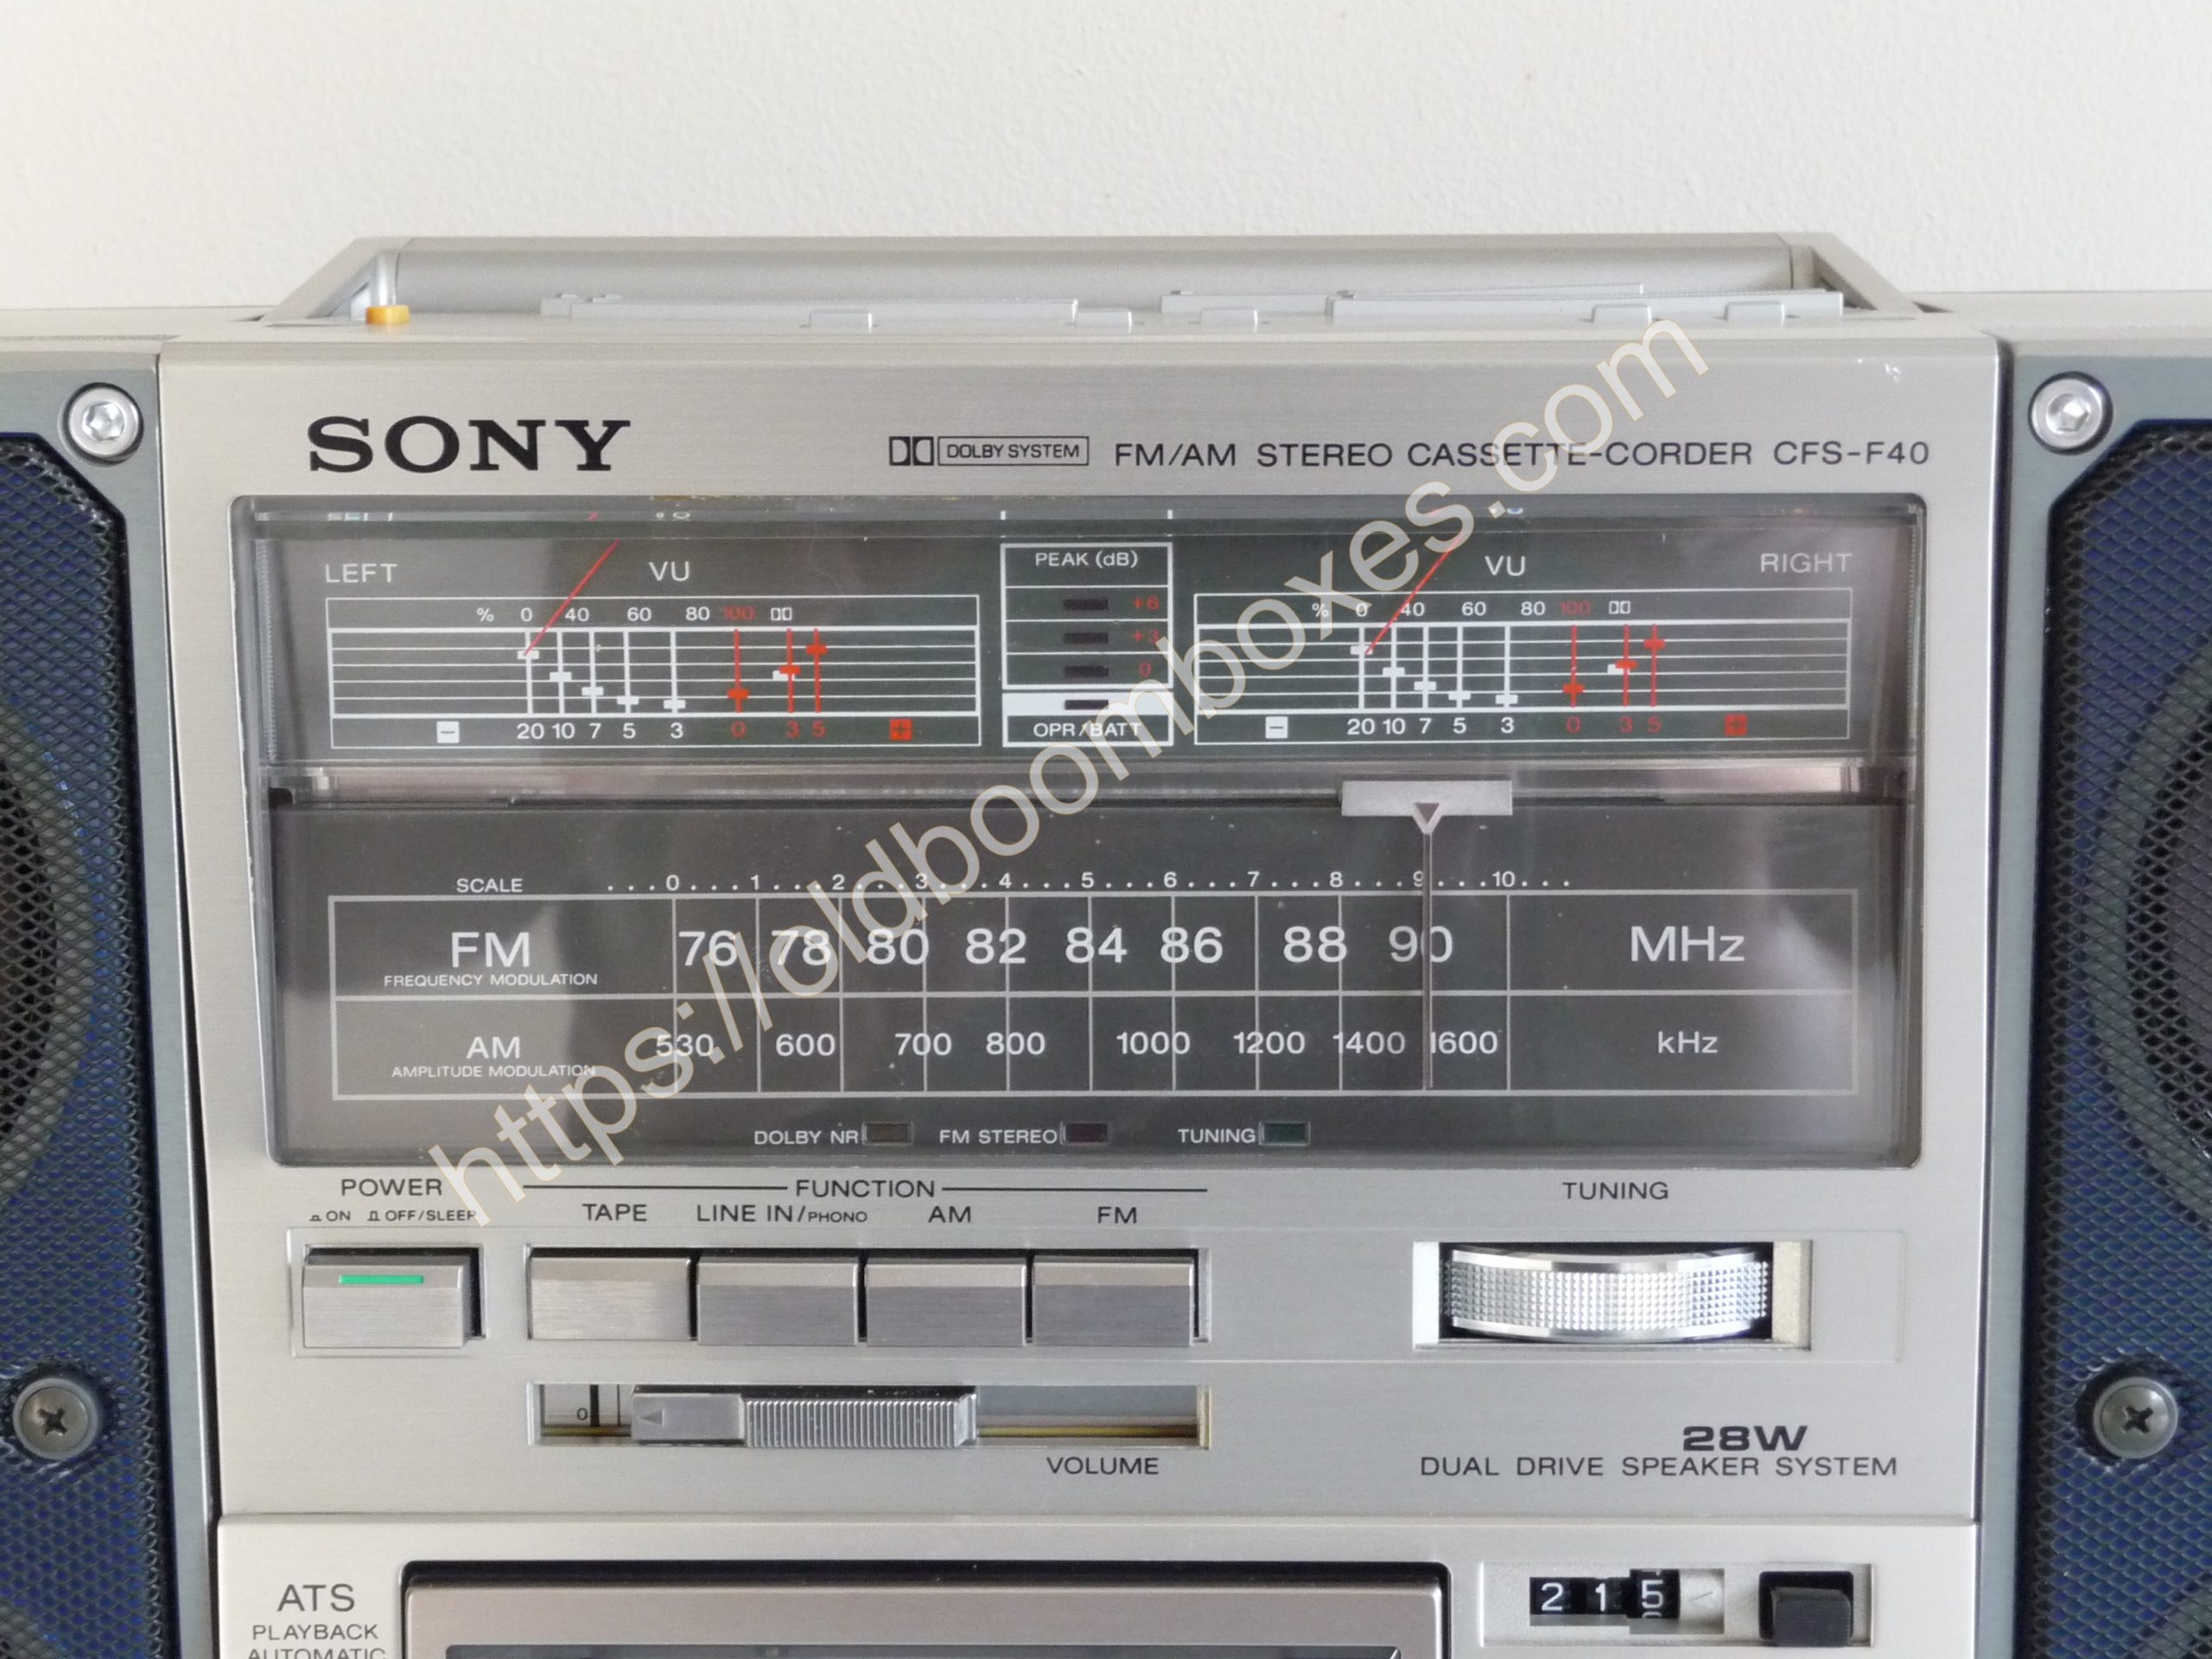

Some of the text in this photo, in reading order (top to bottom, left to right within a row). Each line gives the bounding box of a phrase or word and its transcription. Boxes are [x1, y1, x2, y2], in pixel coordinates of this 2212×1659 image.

[308, 416, 631, 473] SONY
[947, 443, 1079, 458] DOLBY SYSTEM
[1116, 441, 1929, 467] FM/AM STEREO CASSETTE-CORDER CFS-F40
[1035, 550, 1138, 569] PEAK (dB)
[1484, 556, 1526, 576] VU
[1760, 553, 1852, 573] RIGHT
[326, 563, 397, 583] LEFT
[649, 561, 690, 582] VU
[521, 607, 532, 621] 0
[565, 607, 589, 621] 40
[626, 607, 652, 621] 60
[686, 607, 710, 620] 80
[723, 607, 755, 620] 100
[1356, 602, 1368, 617] 0
[1400, 602, 1424, 616] 40
[1462, 601, 1485, 616] 60
[1521, 601, 1545, 615] 80
[1560, 601, 1591, 615] 100
[1139, 663, 1151, 677] 0
[517, 721, 827, 740] 20 10 7 5 3 0 3 5
[1347, 716, 1661, 734] 20 10 7 5 3 0 3 5
[456, 879, 523, 893] SCALE
[666, 874, 679, 891] 0
[750, 874, 760, 890] 1
[832, 874, 845, 890] 2
[915, 874, 927, 889] 3
[999, 873, 1012, 888] 4
[1081, 873, 1094, 888] 5
[1164, 872, 1177, 887] 6
[1247, 872, 1260, 887] 7
[1330, 872, 1343, 887] 8
[1492, 872, 1515, 887] 10
[451, 925, 1745, 968] FM 76 78 80 82 84 86 88 90 MHz
[385, 974, 597, 987] FREQUENCY MODULATION
[466, 1031, 1718, 1058] AM 530 600 700 800 1000 1200 1400 1600 kHz
[391, 1065, 595, 1077] AMPLITUDE MODULATION
[754, 1129, 858, 1145] DOLBY NR
[939, 1129, 1058, 1144] FM STEREO
[1178, 1128, 1255, 1144] TUNING
[340, 1179, 442, 1197] POWER
[796, 1179, 935, 1198] FUNCTION
[1562, 1181, 1669, 1200] TUNING
[326, 1211, 350, 1222] ON
[582, 1204, 647, 1222] TAPE
[696, 1205, 756, 1222] LINE
[928, 1205, 971, 1223] AM
[1097, 1207, 1137, 1224] FM
[1683, 1426, 1808, 1451] 28W
[1046, 1457, 1159, 1475] VOLUME
[1421, 1457, 1897, 1476] DUAL DRIVE SPEAKER SYSTEM
[276, 1584, 354, 1612] ATS
[252, 1624, 378, 1640] PLAYBACK
